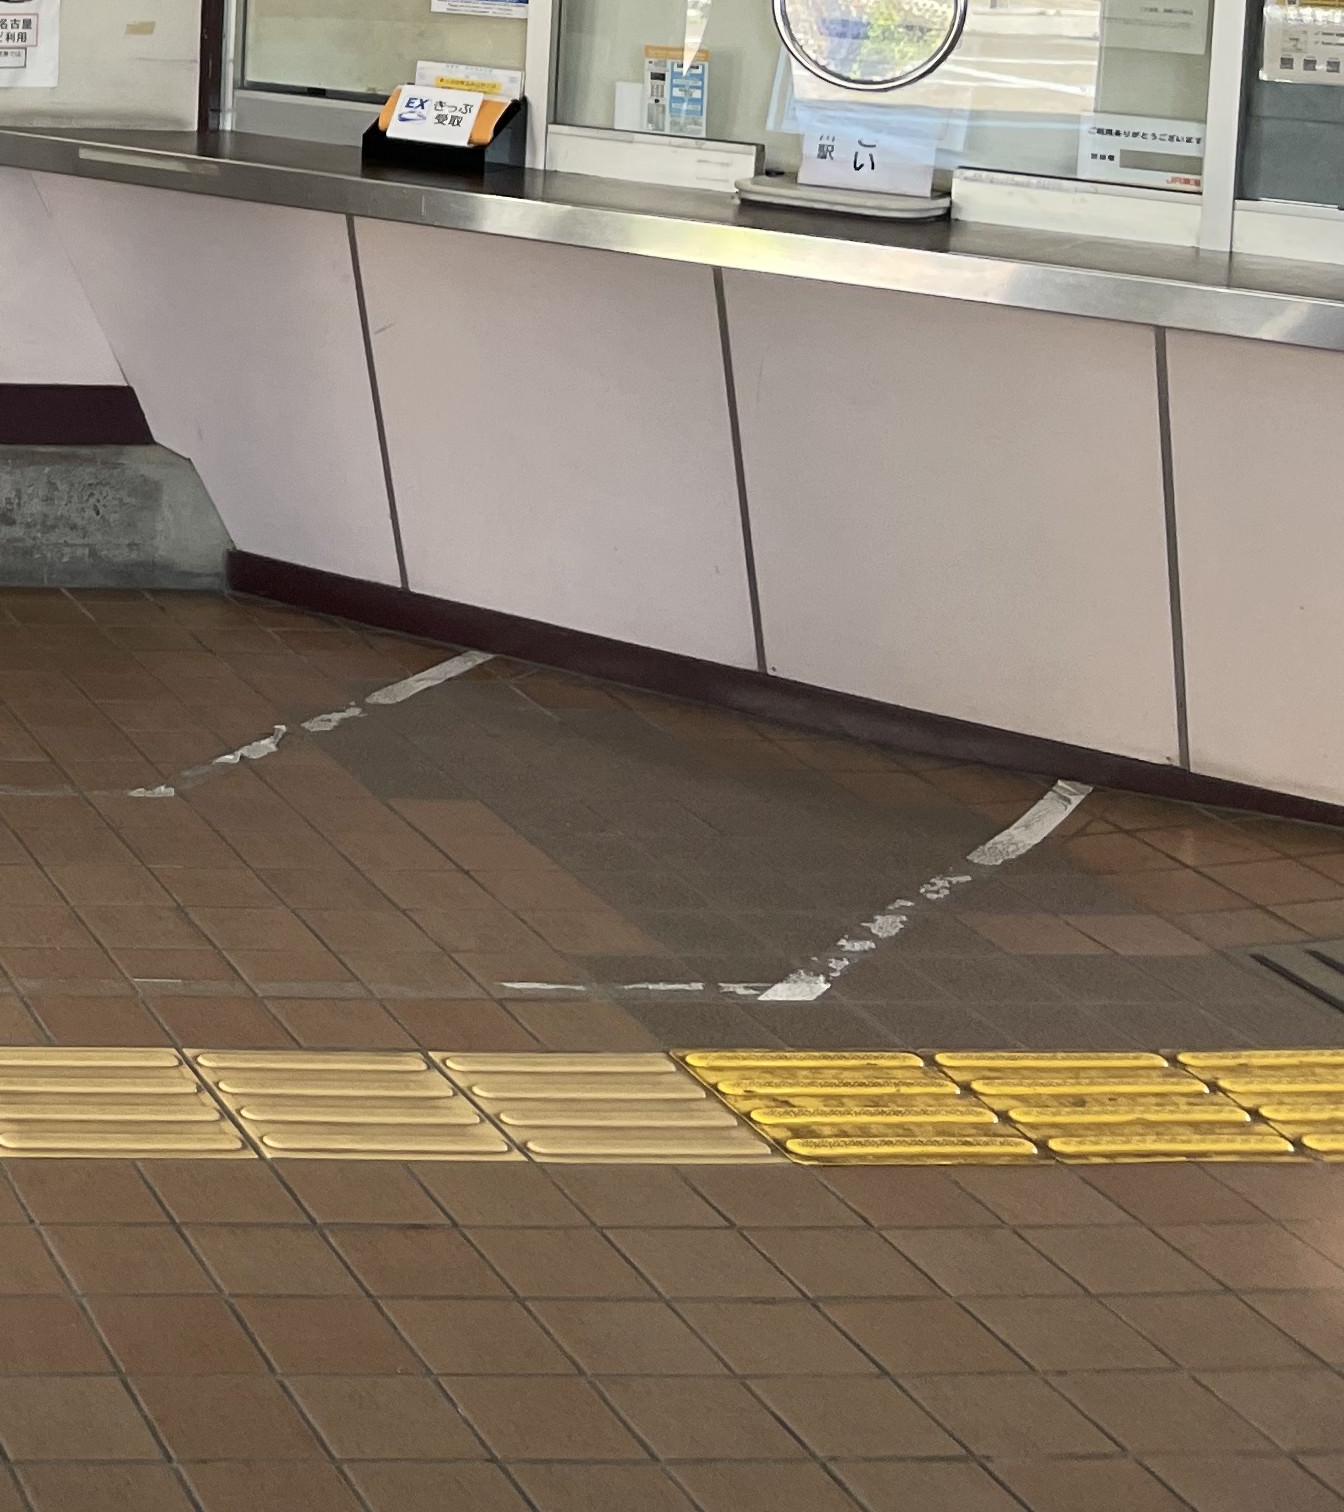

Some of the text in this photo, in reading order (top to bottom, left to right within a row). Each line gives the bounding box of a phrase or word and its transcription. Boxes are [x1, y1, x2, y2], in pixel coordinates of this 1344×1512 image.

[405, 97, 430, 110] EX
[434, 100, 474, 115] きっぷ
[434, 113, 464, 127] 受取
